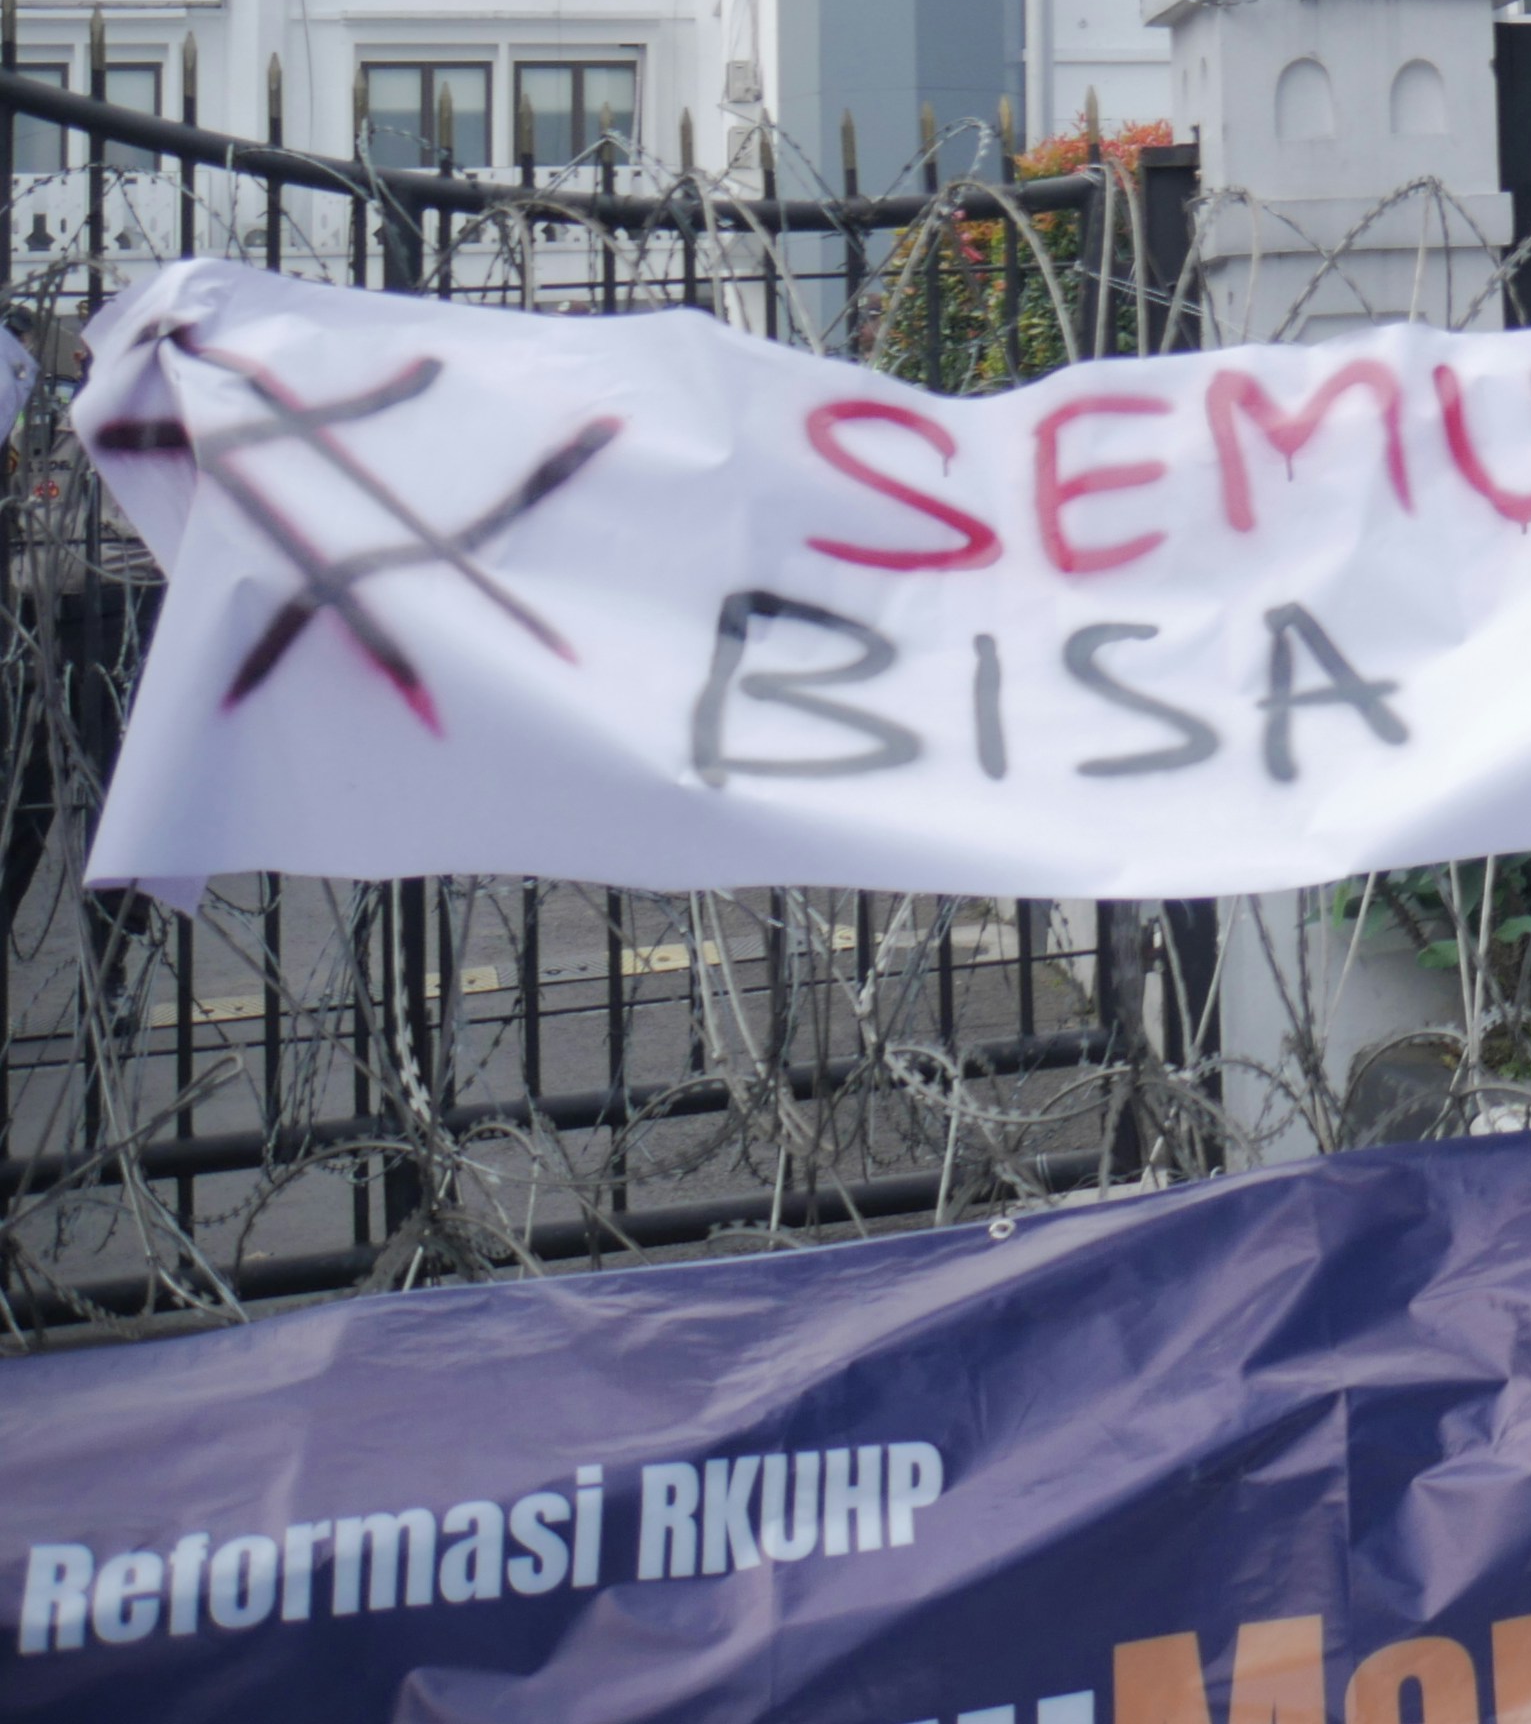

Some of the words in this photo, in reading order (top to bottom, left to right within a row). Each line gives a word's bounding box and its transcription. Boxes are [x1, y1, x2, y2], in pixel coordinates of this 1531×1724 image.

[690, 587, 1412, 788] BISA
[18, 1465, 601, 1655] Reformasi
[636, 1440, 944, 1582] RKUHP
